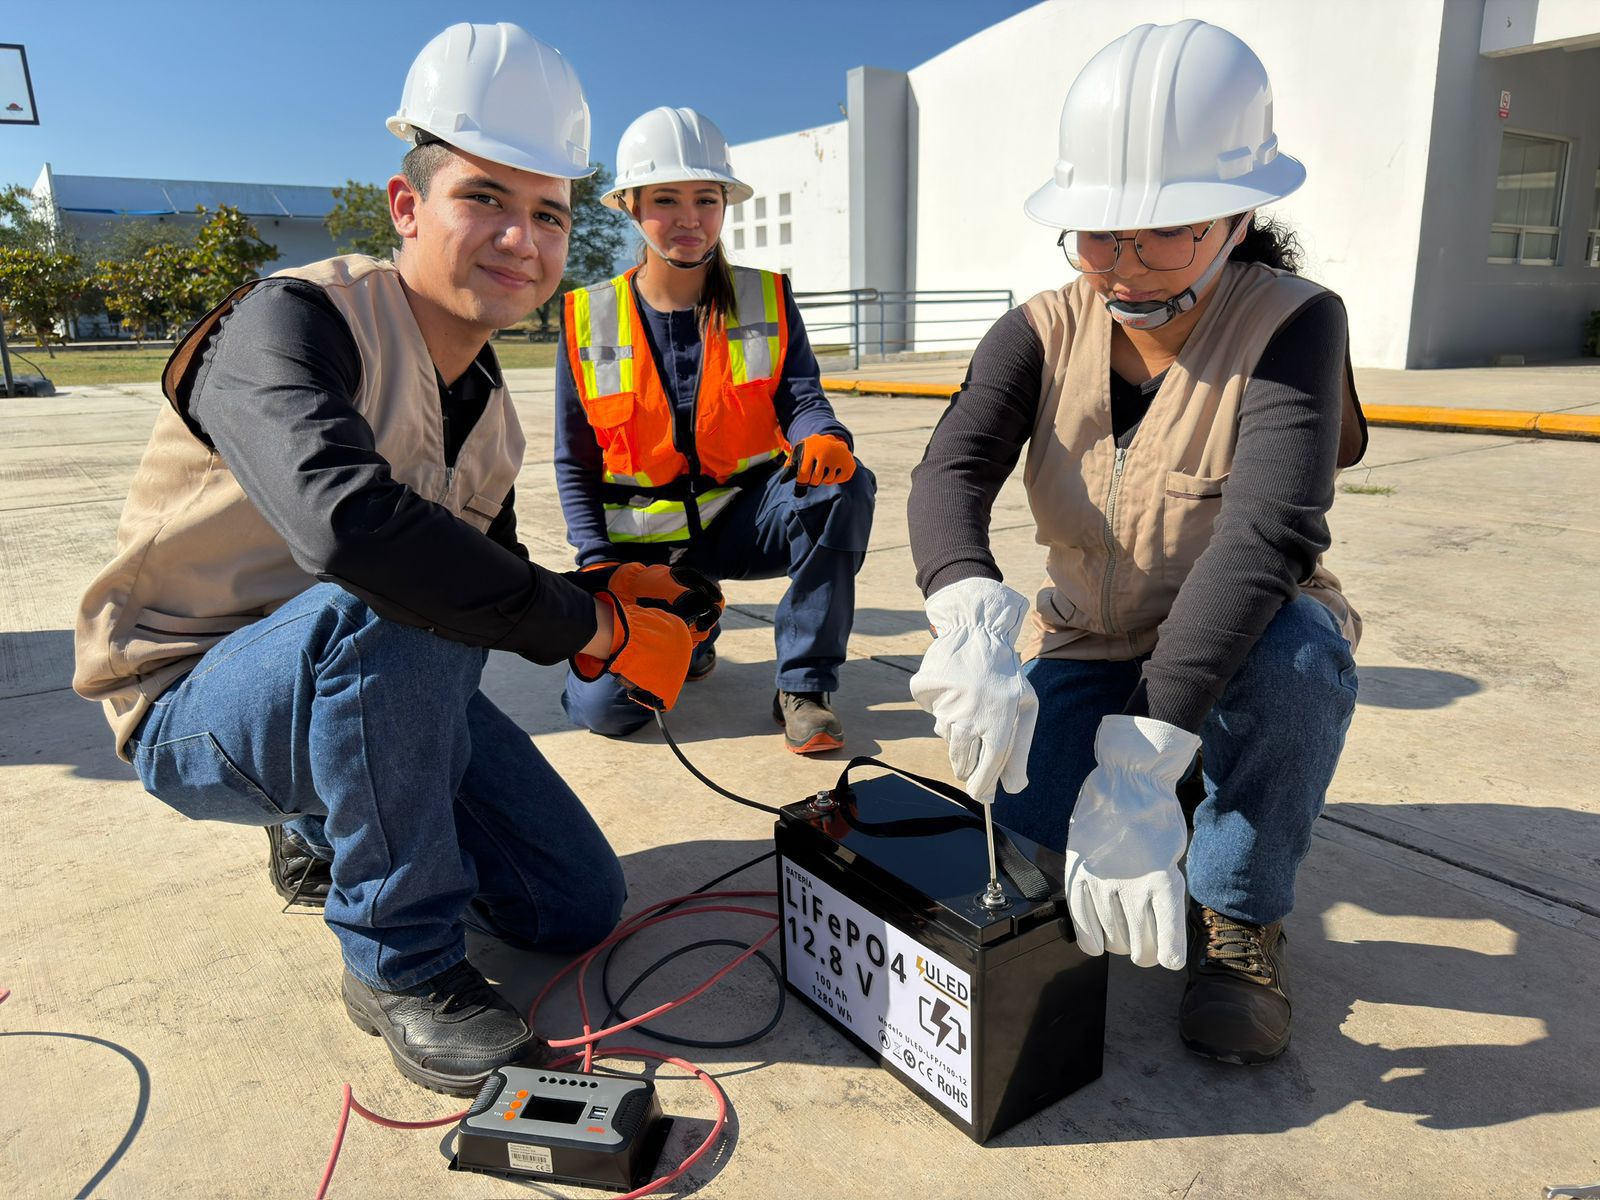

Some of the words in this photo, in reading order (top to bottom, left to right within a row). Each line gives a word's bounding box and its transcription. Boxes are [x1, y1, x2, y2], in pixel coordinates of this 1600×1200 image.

[786, 866, 812, 889] BATERÍA
[788, 917, 842, 976] 12.8
[856, 962, 873, 997] V
[816, 971, 831, 990] 100
[835, 986, 848, 1003] Ah
[926, 960, 968, 1001] ULED
[813, 985, 834, 1008] 1280
[837, 1003, 852, 1023] Wh
[878, 1015, 903, 1038] Modelo
[937, 1074, 968, 1109] RoHS
